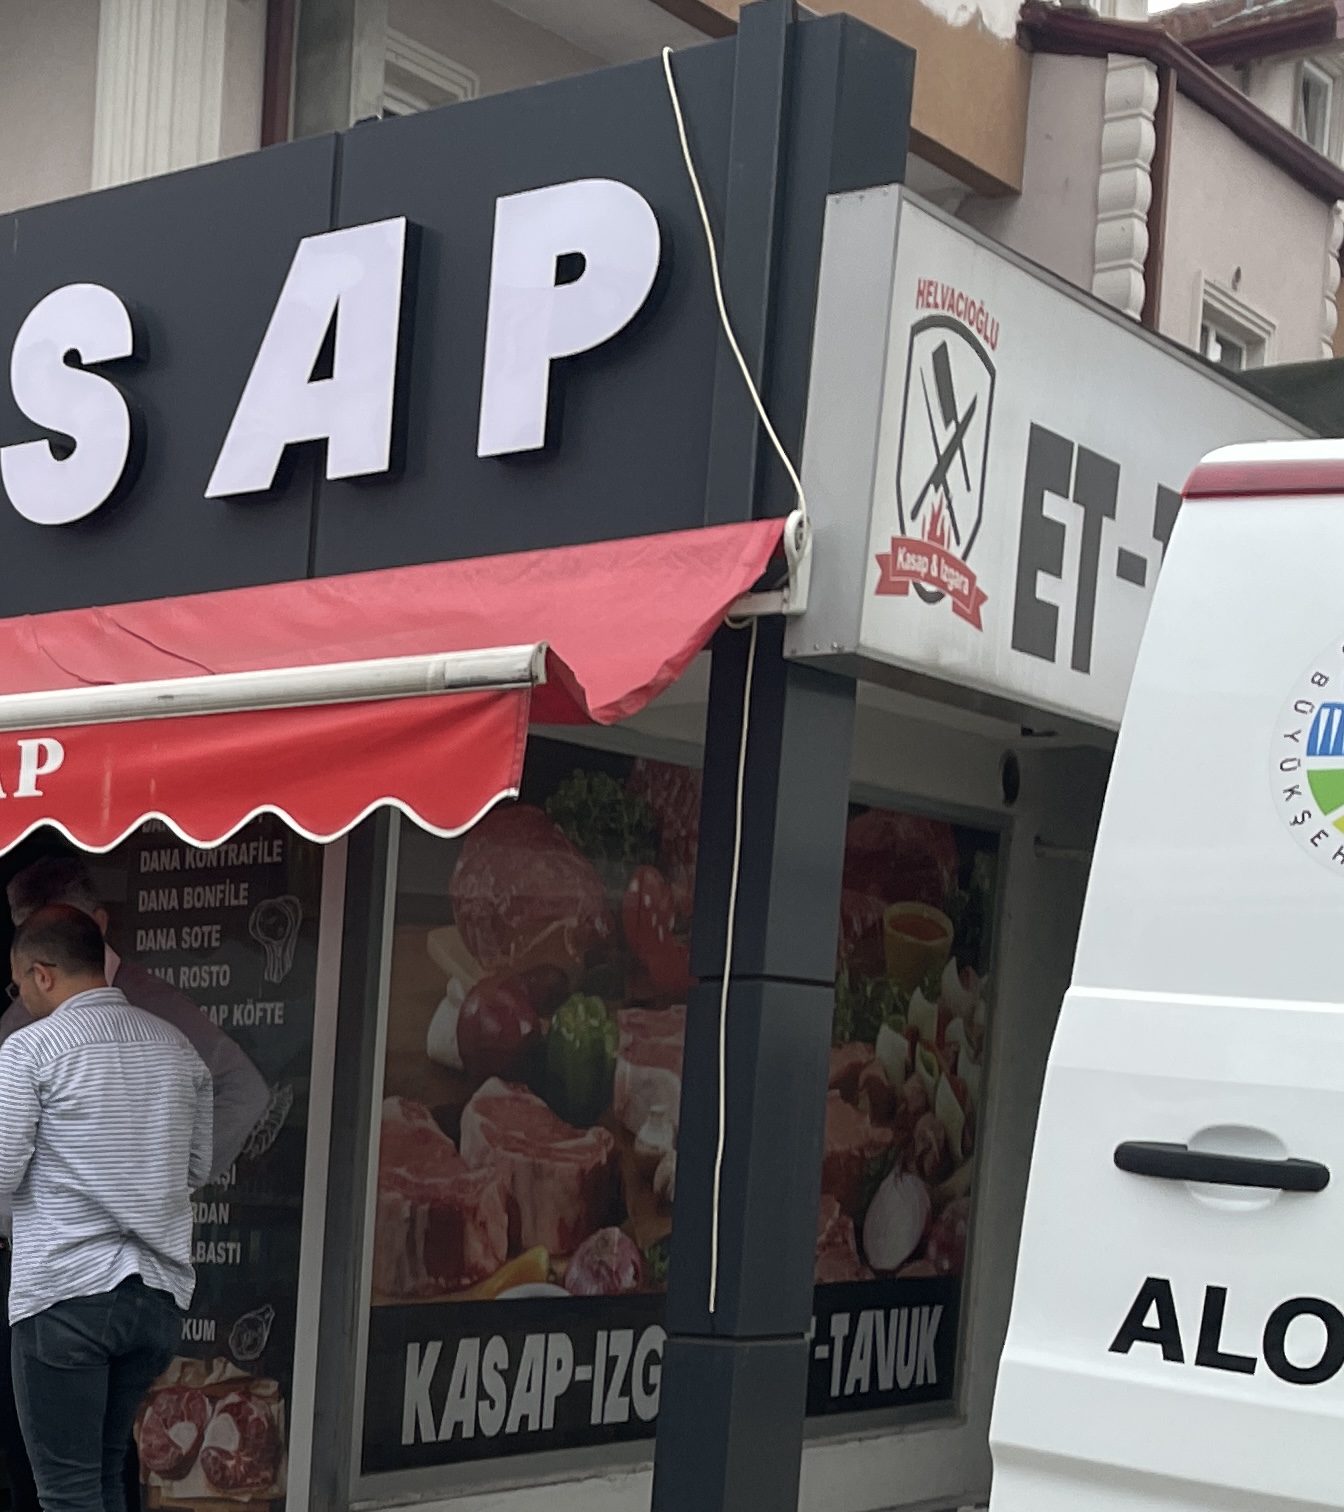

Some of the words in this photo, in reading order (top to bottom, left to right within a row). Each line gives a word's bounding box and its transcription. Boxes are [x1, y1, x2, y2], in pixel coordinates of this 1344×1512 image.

[140, 850, 181, 873] DANA
[185, 838, 283, 869] KONTRAFİLE
[138, 888, 179, 912] DANA
[183, 878, 249, 909] BONFİLE
[136, 928, 176, 951] DANA
[181, 924, 222, 949] SOTE
[179, 964, 231, 989] ROSTO
[232, 999, 284, 1026] KÖFTE
[192, 1202, 229, 1225] RDAN
[189, 1241, 241, 1265] BASTI
[1108, 1275, 1344, 1386] ALO
[809, 1305, 944, 1398] -TAVUK
